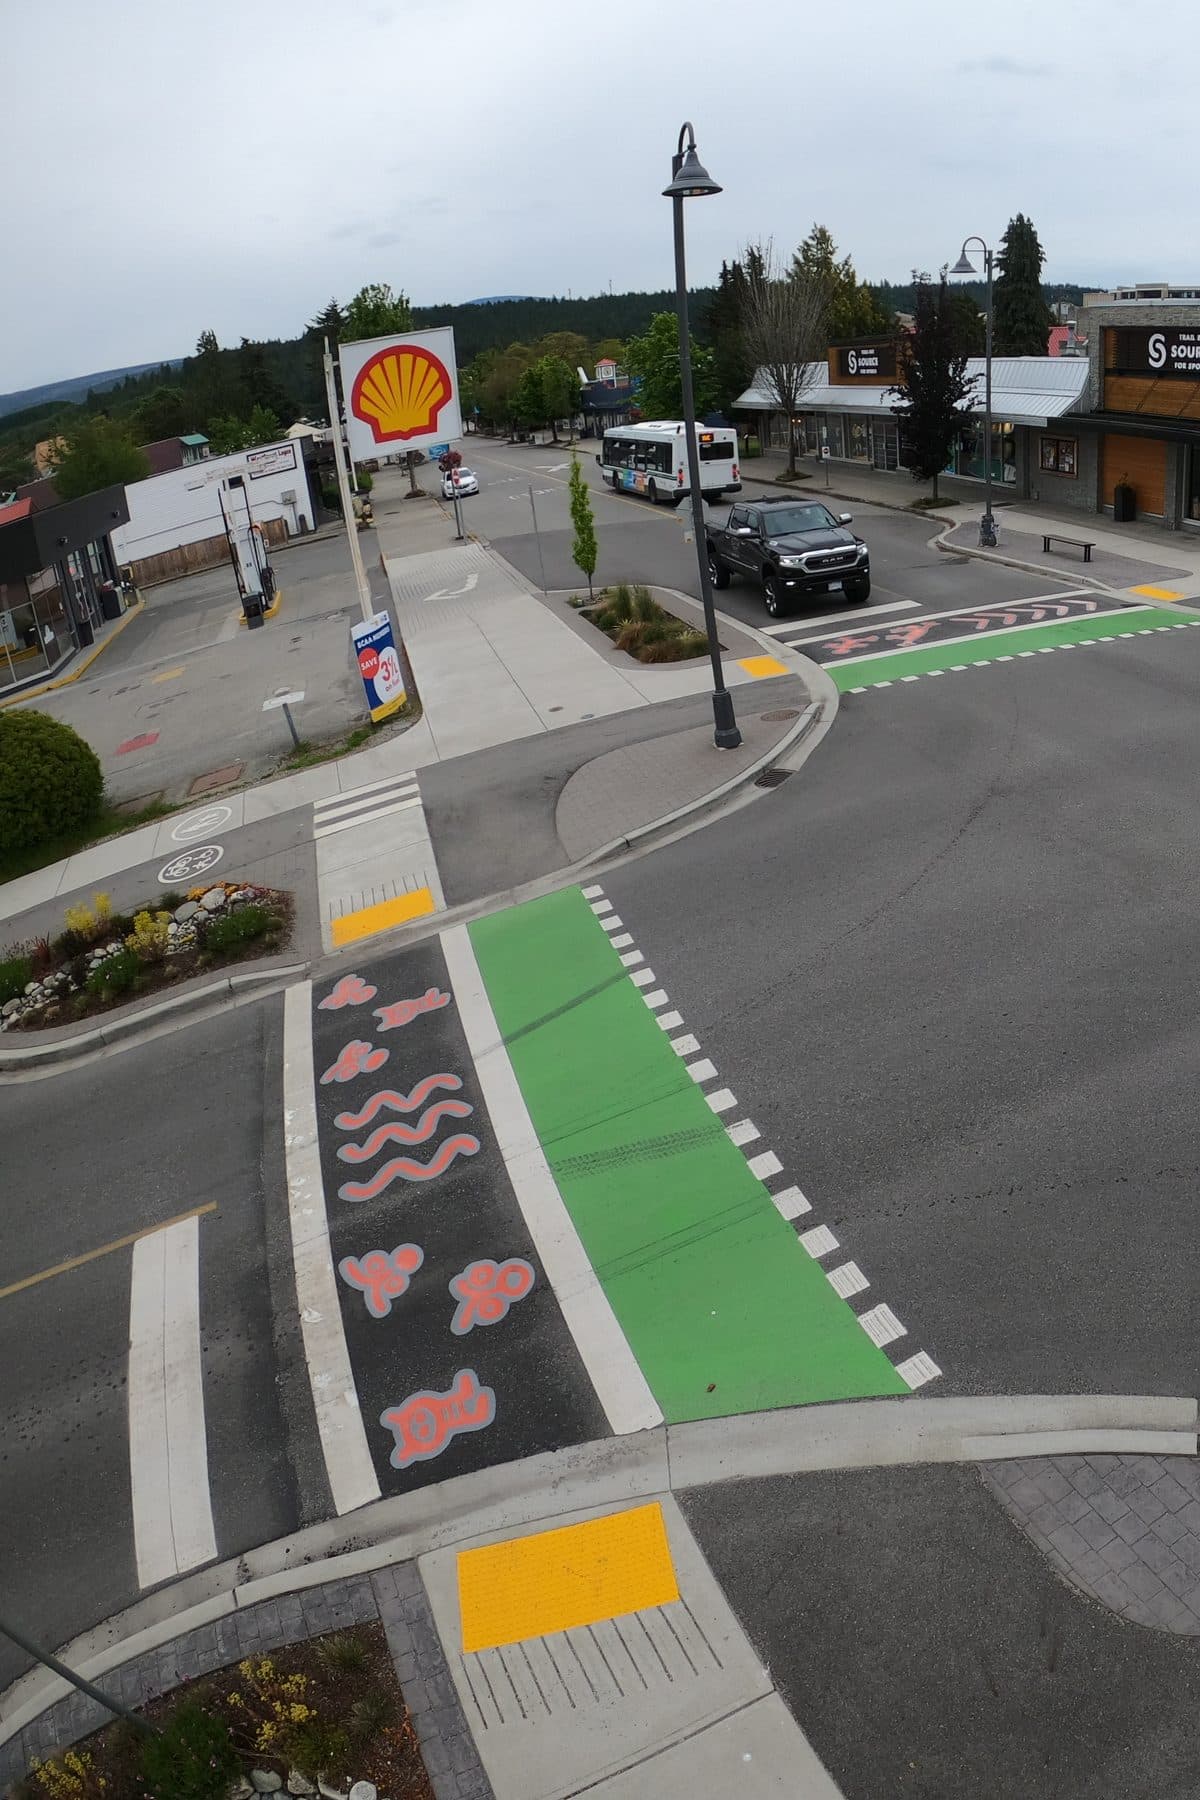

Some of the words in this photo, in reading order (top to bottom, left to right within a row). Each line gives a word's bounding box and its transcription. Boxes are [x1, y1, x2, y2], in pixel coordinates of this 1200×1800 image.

[1179, 334, 1195, 342] TRAIL
[1174, 362, 1187, 370] FOR
[360, 656, 378, 671] SAVE
